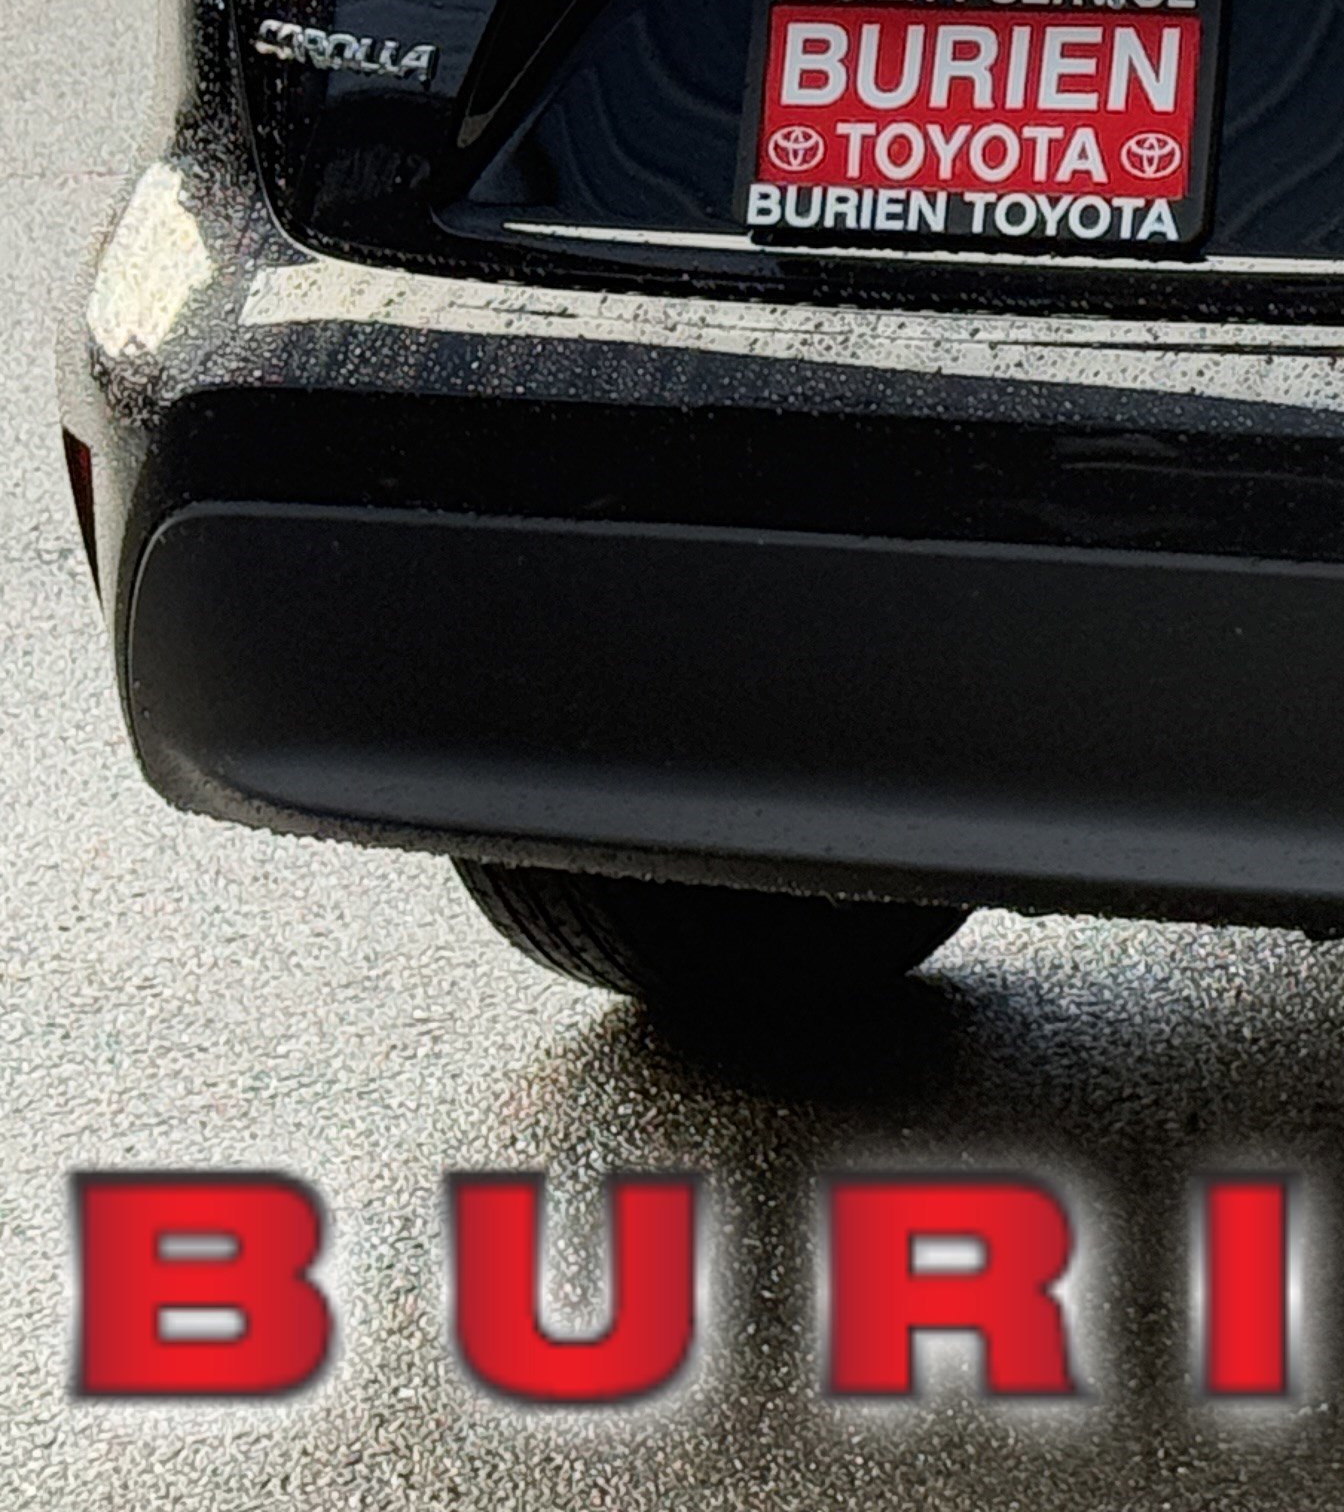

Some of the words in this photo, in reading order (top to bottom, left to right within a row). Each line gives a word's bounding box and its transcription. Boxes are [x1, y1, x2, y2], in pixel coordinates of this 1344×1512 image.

[253, 19, 438, 81] COROLLA
[780, 22, 1181, 113] BURIEN
[835, 120, 1107, 184] TOYOTA
[746, 182, 948, 232] BURIEN
[963, 192, 1179, 241] TOYOTA
